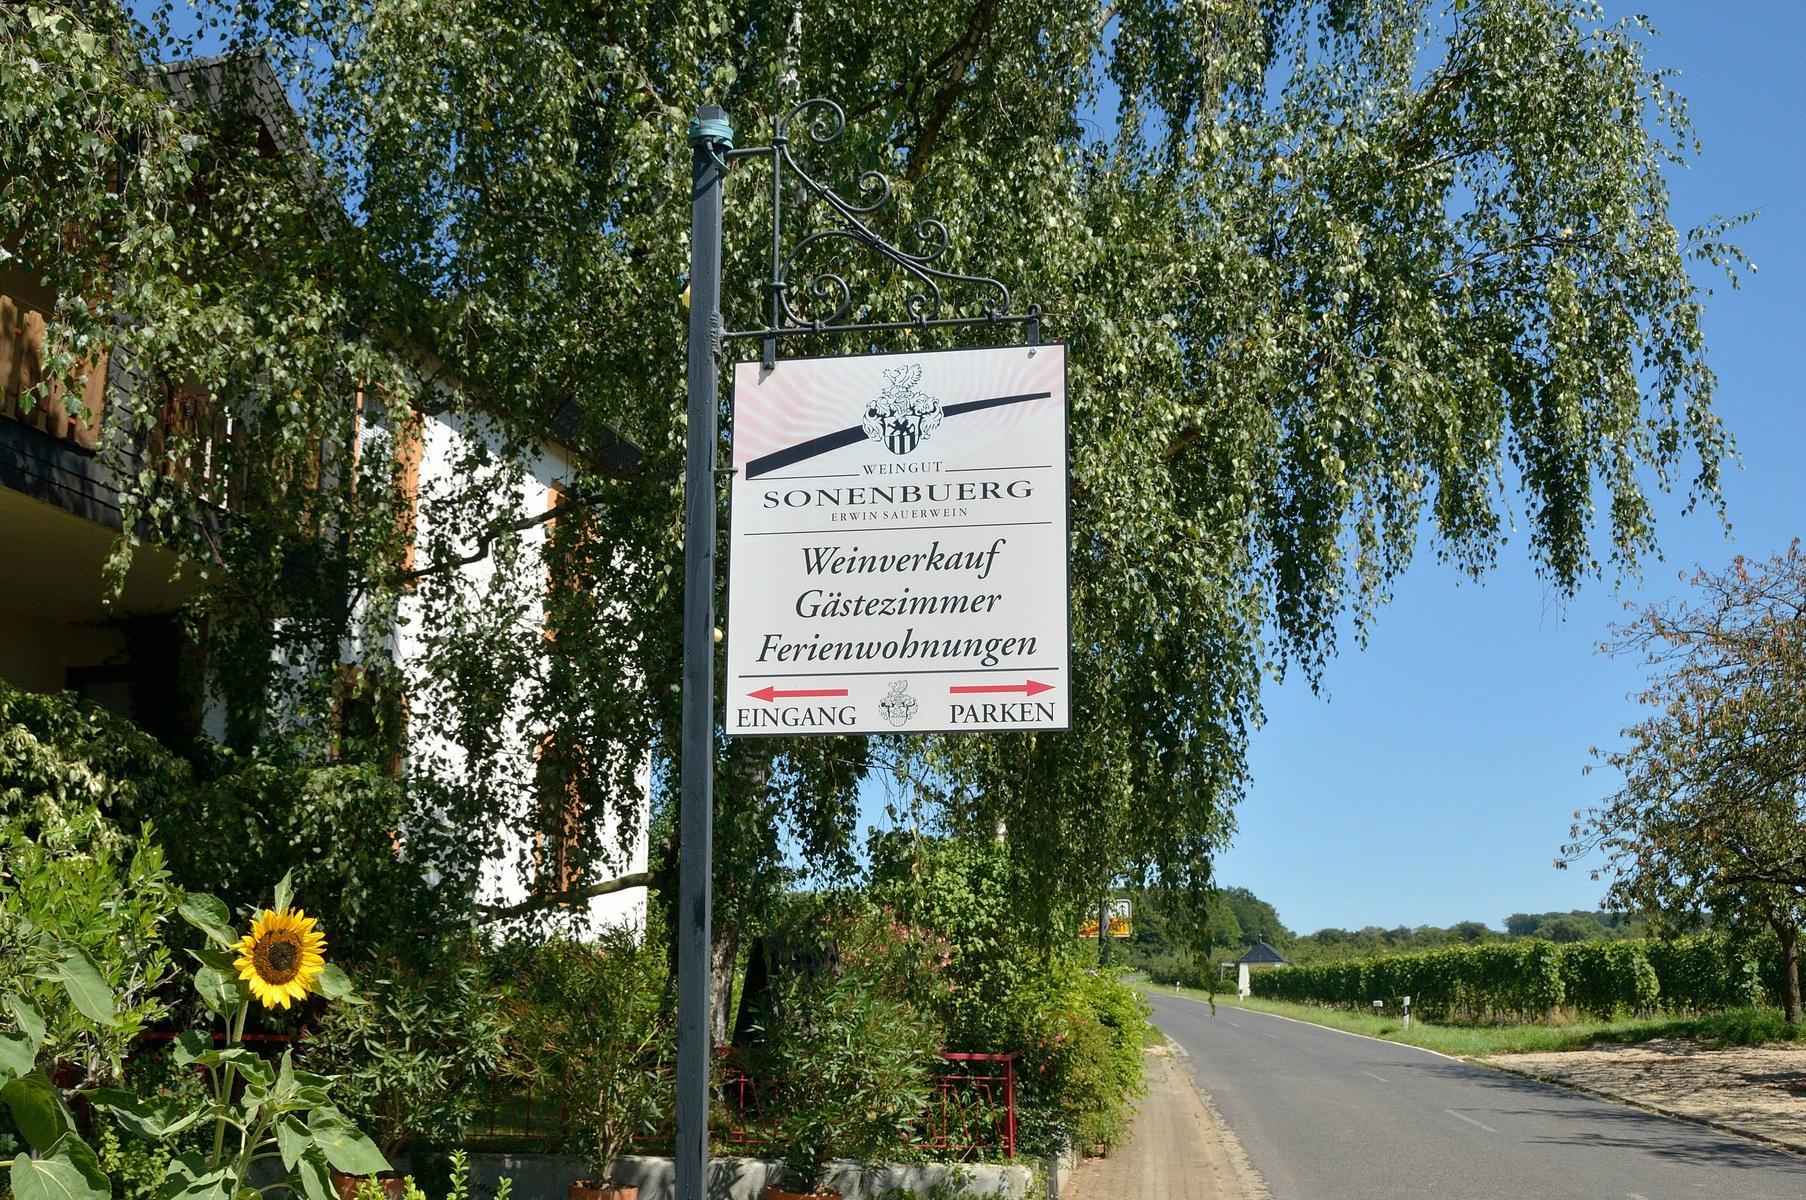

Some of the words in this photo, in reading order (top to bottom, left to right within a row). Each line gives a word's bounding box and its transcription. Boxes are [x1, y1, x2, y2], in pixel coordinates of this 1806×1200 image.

[863, 461, 943, 475] WEINGUT
[763, 480, 1033, 509] SONENBUERG
[831, 511, 878, 522] ERWIN
[883, 507, 968, 521] SAUERWEIN
[801, 538, 1006, 580] Weinverkauf
[795, 587, 1002, 619] Gästezimmer
[755, 628, 1037, 667] Ferienwohnungen
[736, 705, 857, 728] EINGANG
[949, 702, 1056, 724] PARKEN
